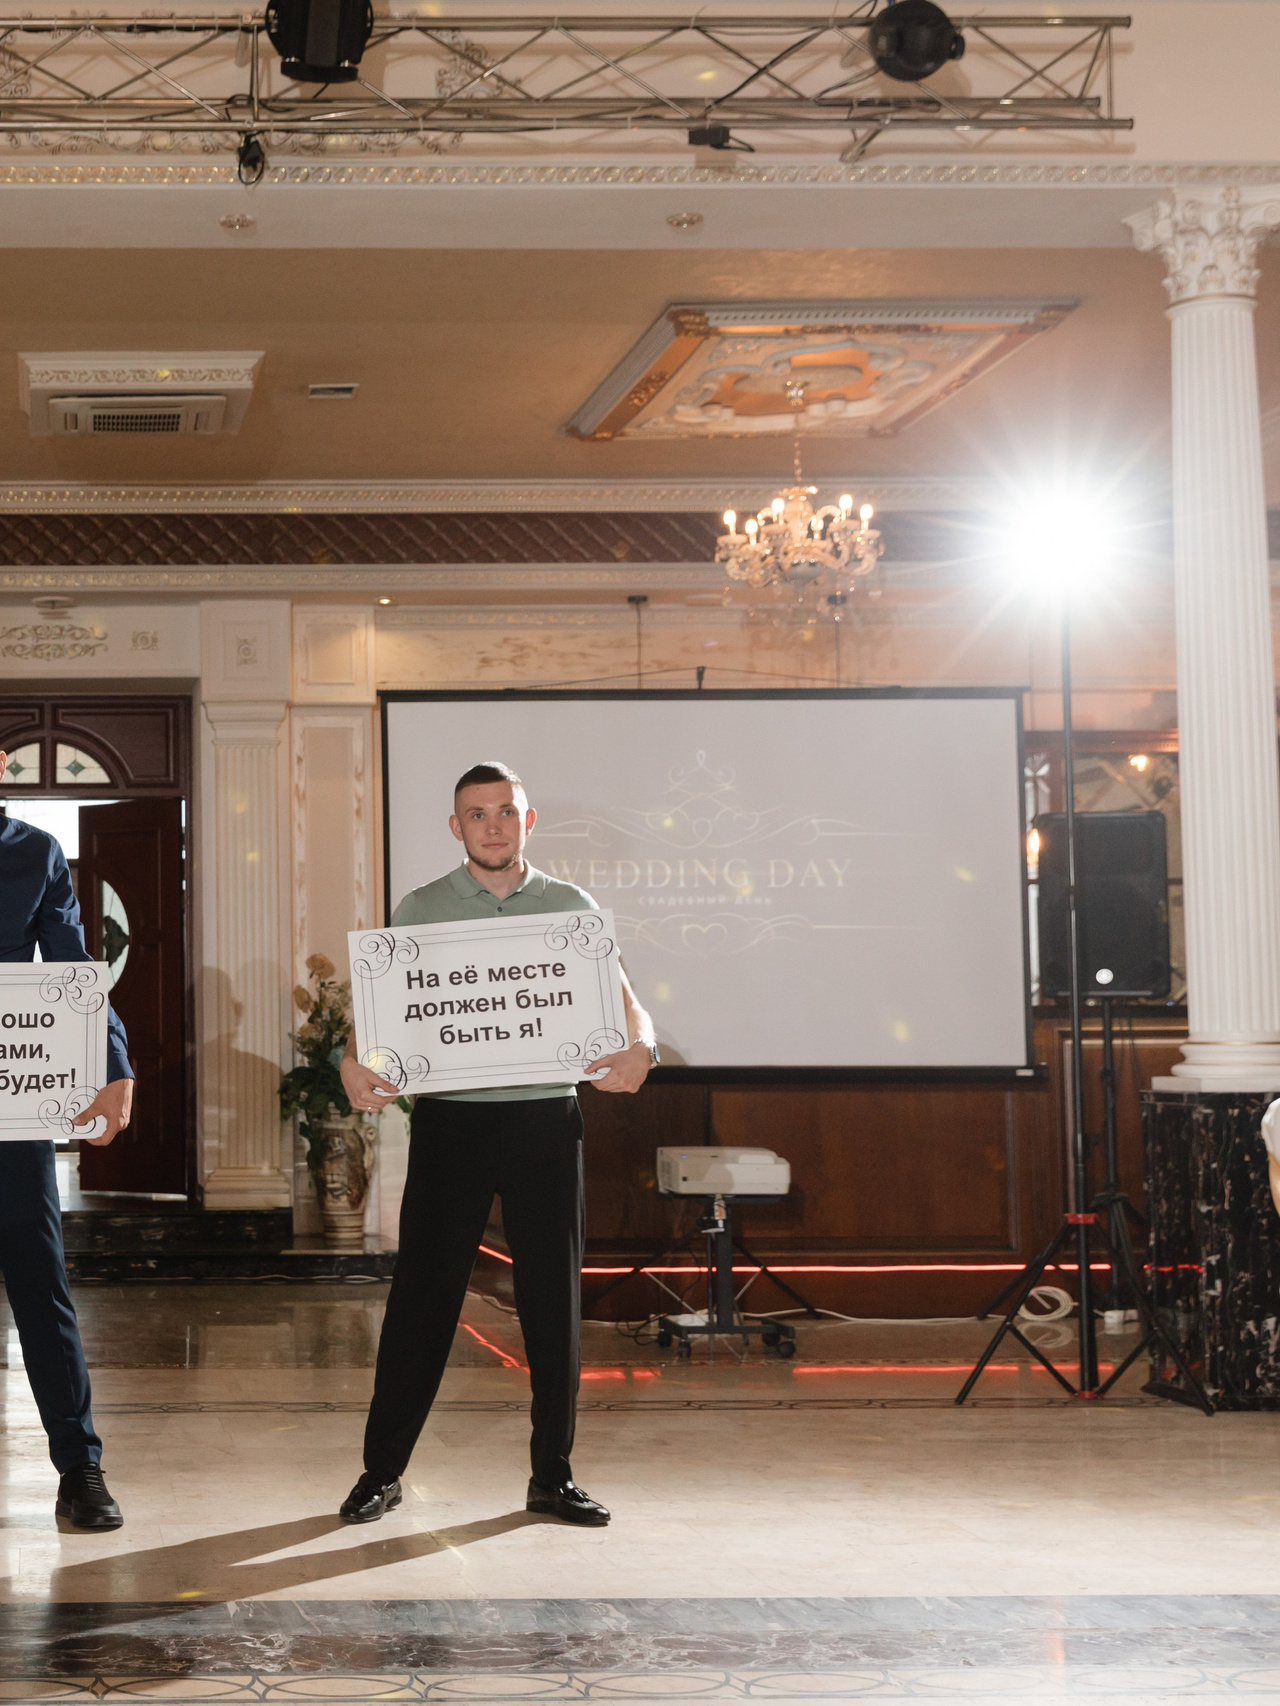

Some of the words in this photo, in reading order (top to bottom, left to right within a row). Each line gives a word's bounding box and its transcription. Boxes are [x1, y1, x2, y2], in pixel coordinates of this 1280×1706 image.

[547, 858, 751, 889] WEDDING
[768, 858, 853, 888] DAY
[406, 969, 441, 990] На
[448, 964, 479, 986] её
[487, 962, 566, 983] месте
[404, 996, 507, 1023] должен
[515, 988, 573, 1009] был
[439, 1024, 511, 1045] быть
[519, 1017, 543, 1039] я!
